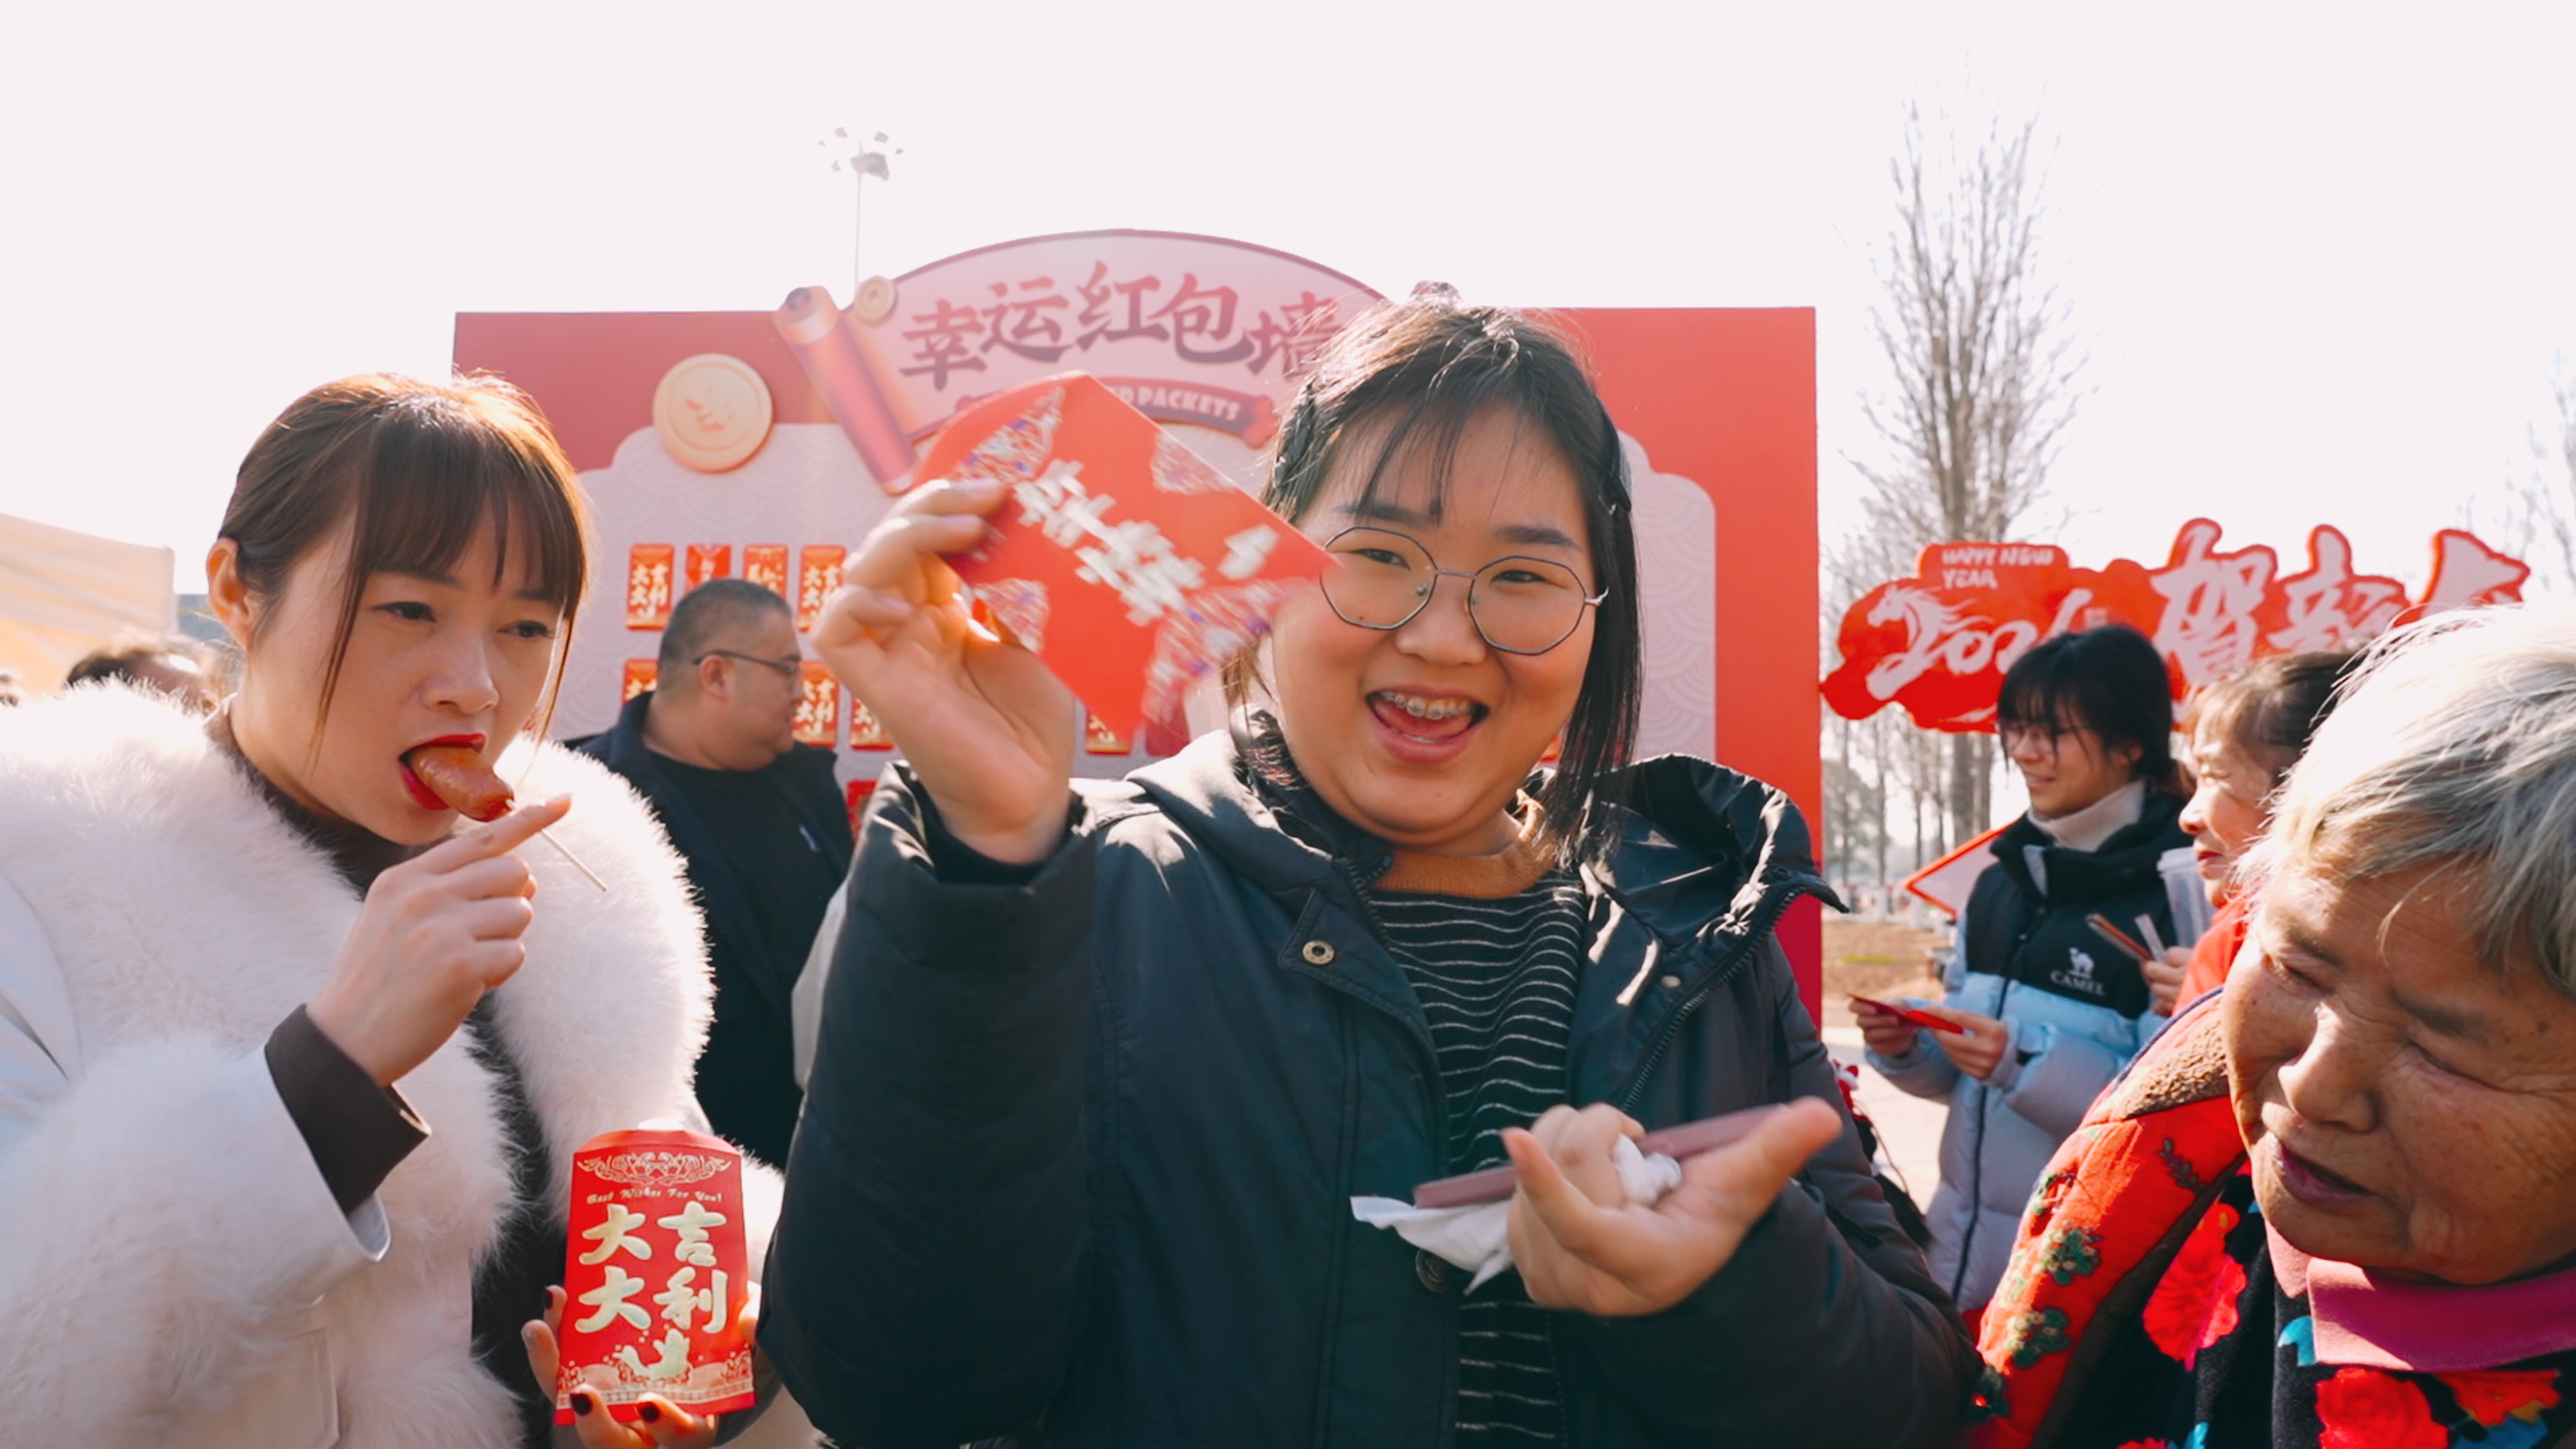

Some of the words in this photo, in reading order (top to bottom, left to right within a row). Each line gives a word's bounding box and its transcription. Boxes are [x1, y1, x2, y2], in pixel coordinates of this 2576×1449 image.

[900, 260, 1342, 392] 幸运红包墙
[1138, 386, 1240, 421] PACKETS
[1942, 548, 1996, 565] HAPPY
[1942, 569, 1998, 589] YEAR
[2050, 969, 2106, 997] CAMEL
[667, 1188, 689, 1199] For
[695, 1191, 722, 1202] You!
[578, 1200, 727, 1267] 大吉
[574, 1265, 729, 1334] 大利
